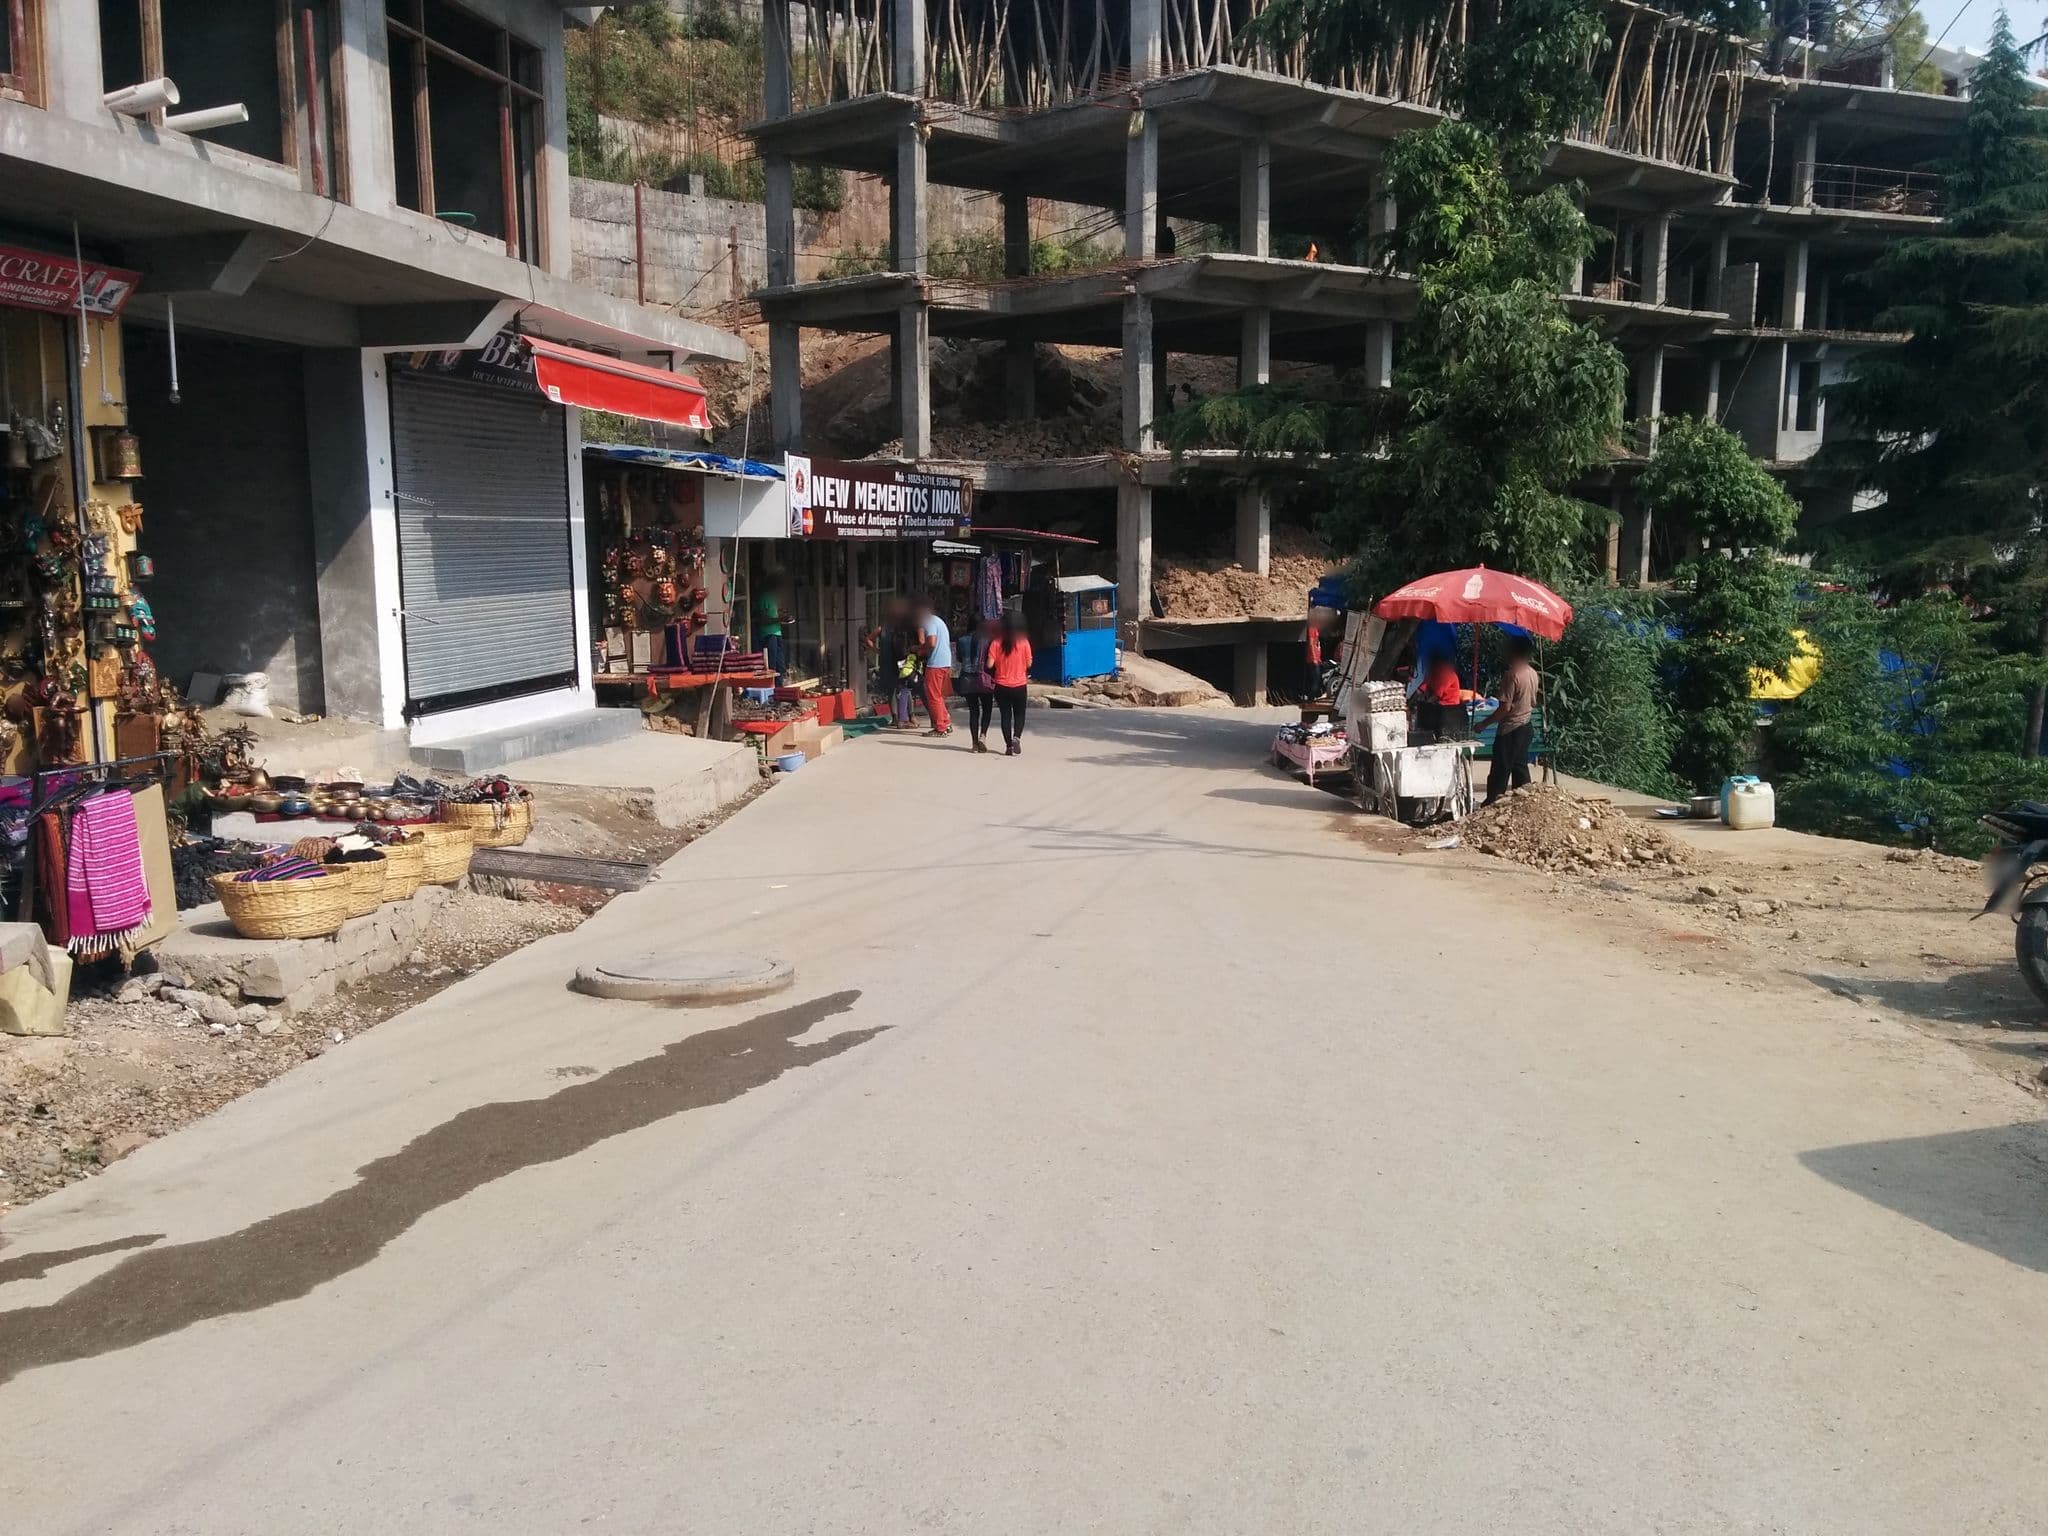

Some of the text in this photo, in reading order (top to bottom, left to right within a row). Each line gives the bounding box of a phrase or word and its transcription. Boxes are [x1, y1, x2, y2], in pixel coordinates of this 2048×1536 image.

[812, 475, 961, 515] NEW MEMENTOS INDIA
[824, 509, 832, 524] A
[832, 510, 857, 525] House
[858, 512, 866, 525] of
[868, 512, 897, 529] Antiques
[898, 515, 904, 527] &
[904, 514, 926, 527] Tibetan
